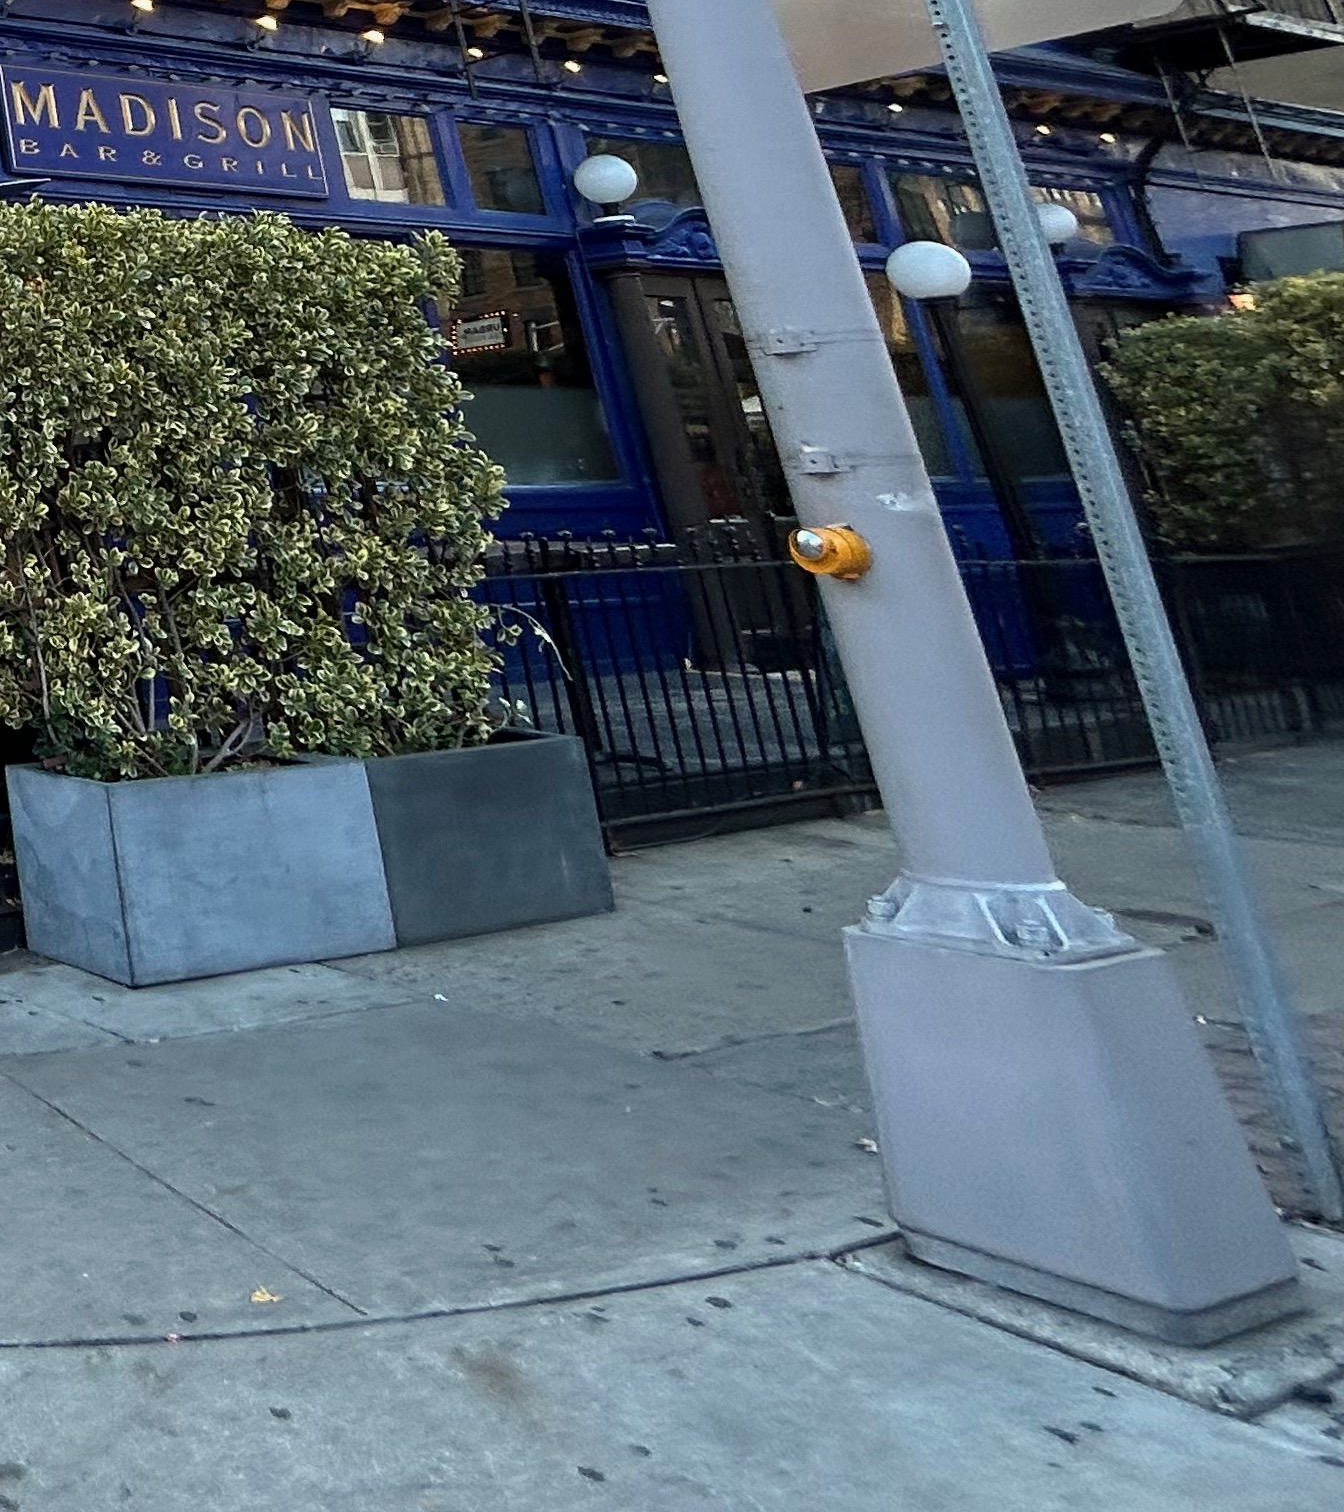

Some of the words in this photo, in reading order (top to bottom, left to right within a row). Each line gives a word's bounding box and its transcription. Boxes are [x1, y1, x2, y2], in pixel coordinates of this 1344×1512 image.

[10, 80, 316, 153] MADISON
[18, 138, 117, 162] BAR
[141, 149, 162, 166] &
[183, 153, 322, 180] GRILL
